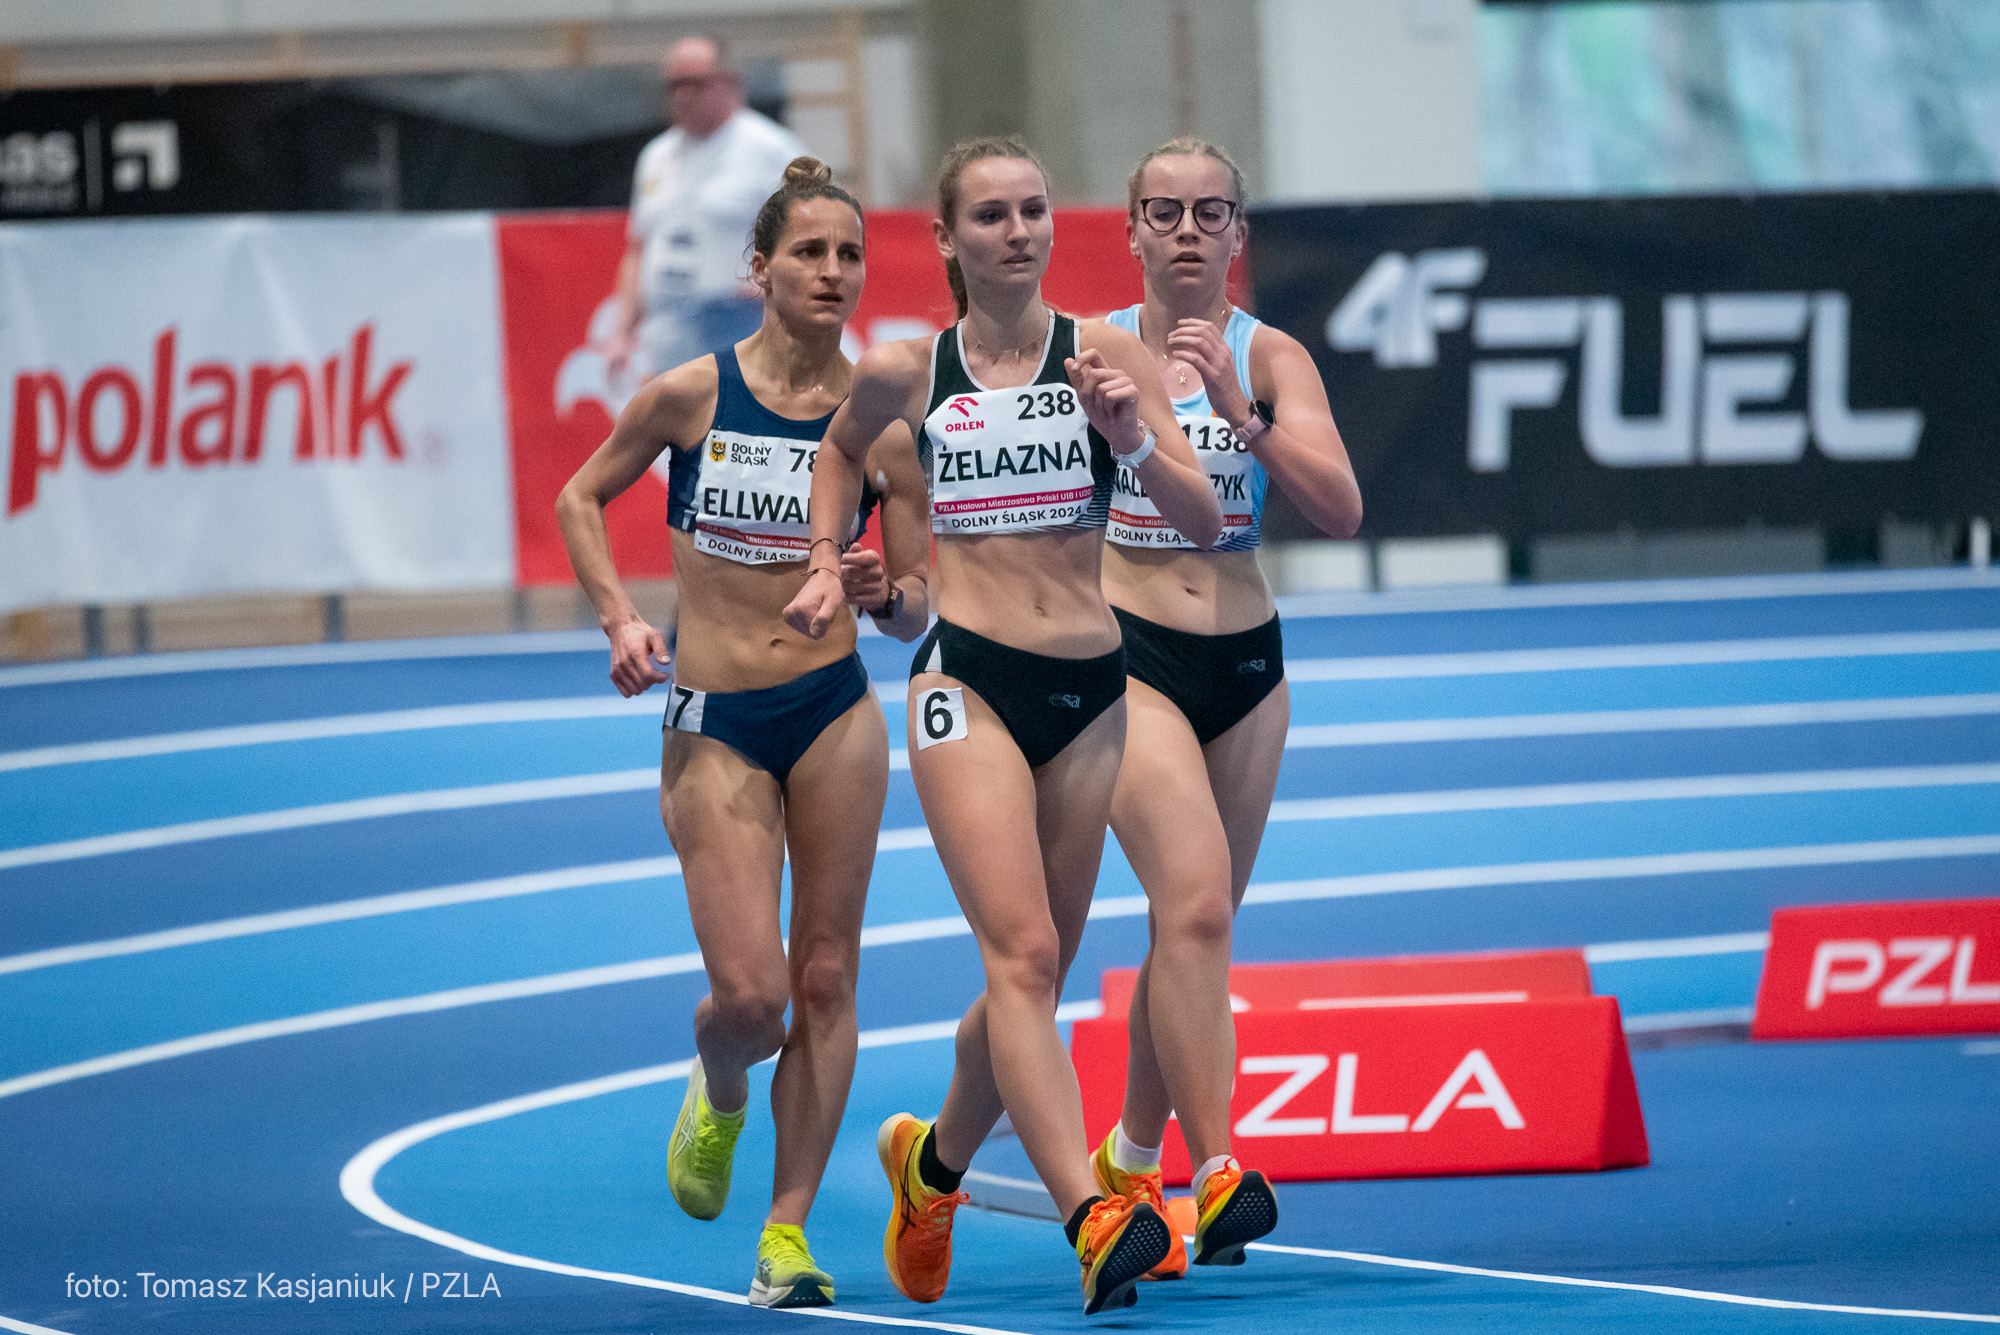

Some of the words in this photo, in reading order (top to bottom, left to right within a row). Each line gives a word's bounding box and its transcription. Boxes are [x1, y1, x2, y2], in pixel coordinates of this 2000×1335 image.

[1327, 248, 1486, 367] 4F
[1467, 291, 1923, 470] FUEL
[5, 320, 415, 518] polanik
[1016, 389, 1076, 421] 238
[945, 420, 985, 432] ORLEN
[731, 442, 772, 456] DOLNY
[938, 440, 1087, 483] ŻELAZNA
[703, 486, 811, 525] ELLWA
[938, 504, 956, 513] PZLA
[957, 499, 987, 511] Halowe
[987, 494, 1035, 508] Mistrzostwa
[1036, 492, 1060, 504] Polski
[1060, 490, 1074, 500] U18
[1079, 487, 1093, 499] U20
[951, 515, 998, 529] DOLNY
[1002, 509, 1047, 525] ŚLĄSK
[1050, 504, 1083, 520] 2024
[707, 538, 752, 559] DOLNY
[1114, 527, 1153, 543] DOLNY
[672, 685, 695, 729] 7
[924, 691, 954, 740] 6
[1231, 1048, 1526, 1139] ZLA
